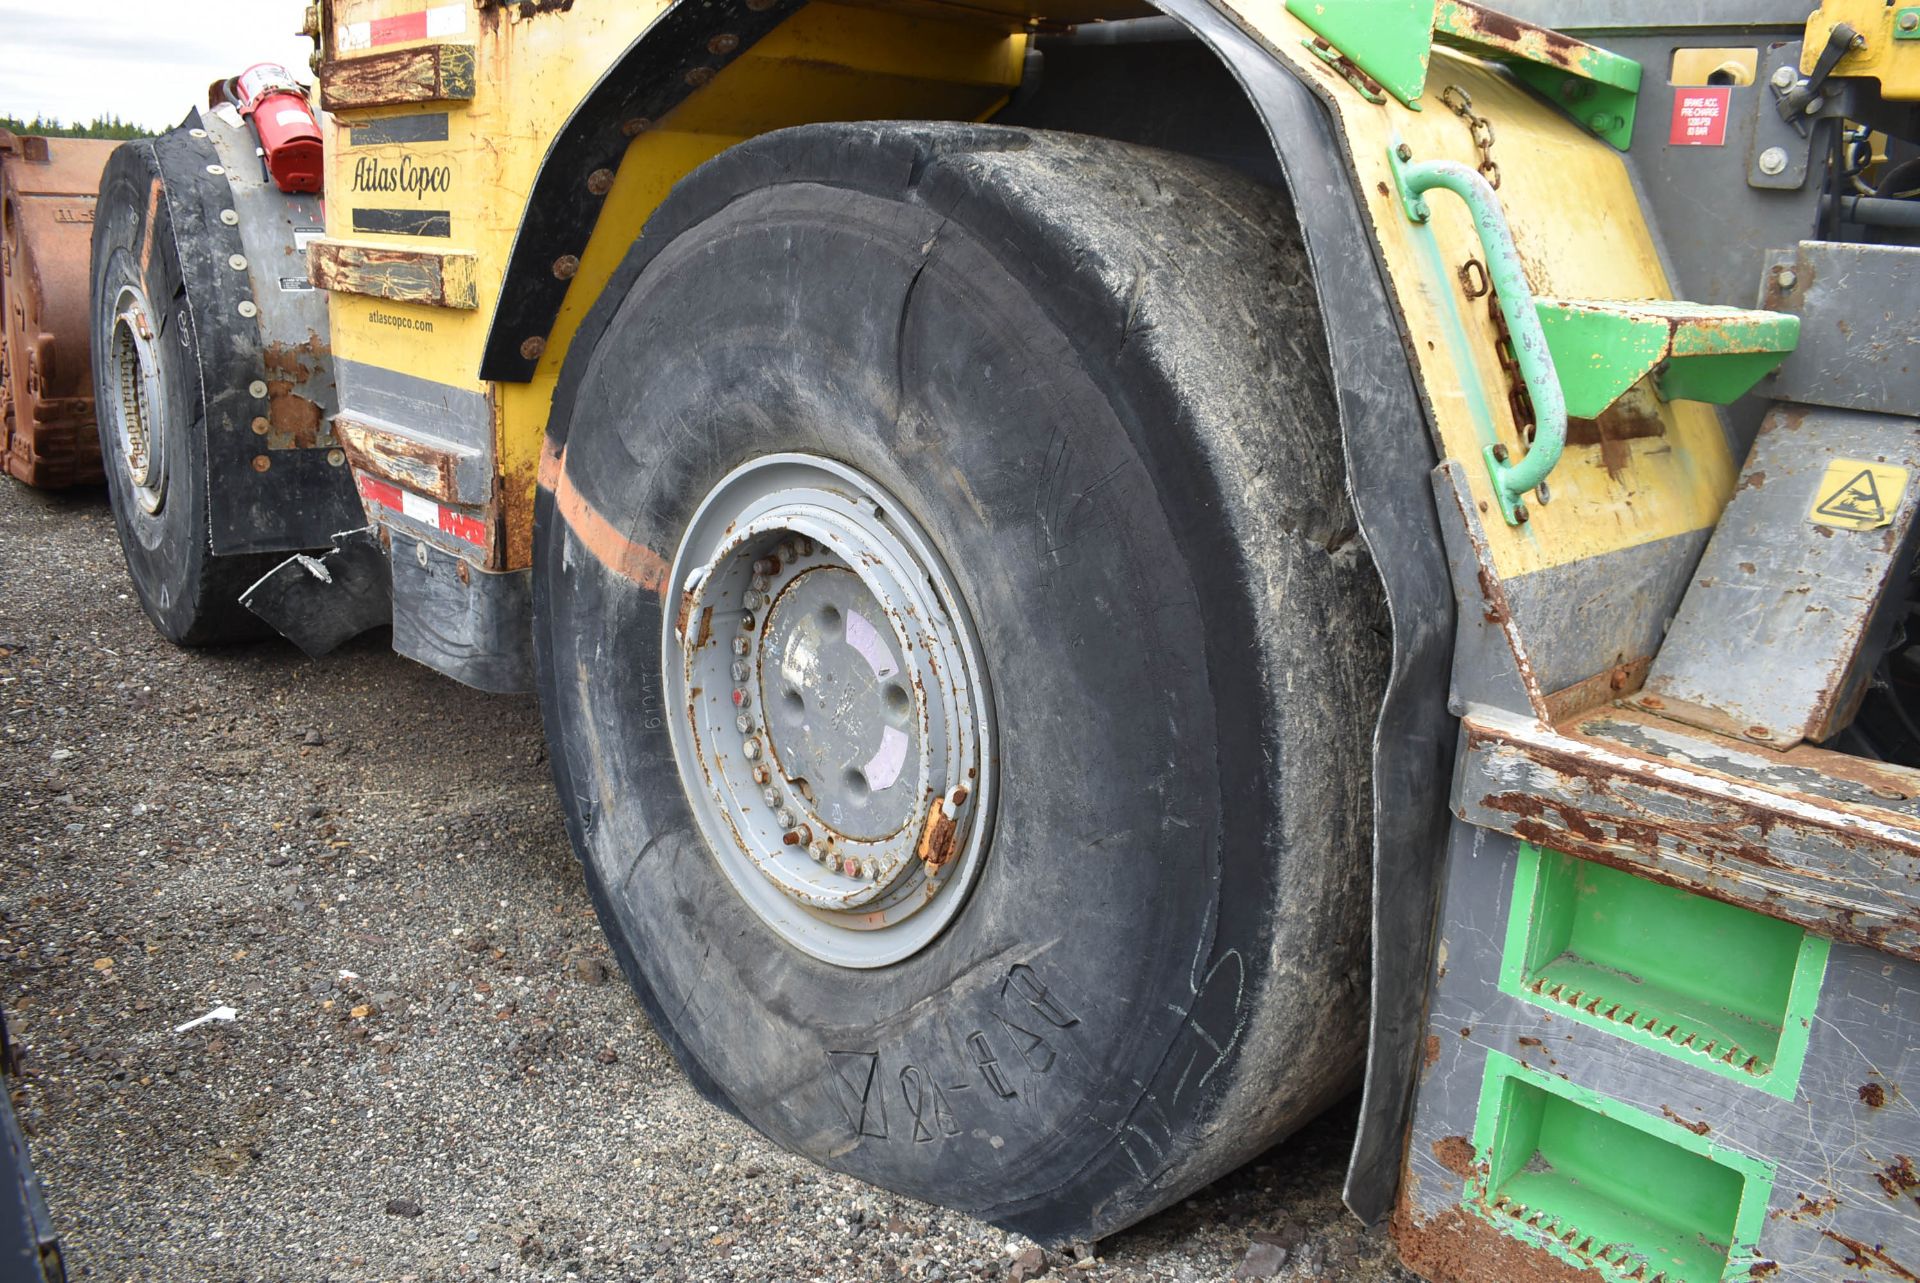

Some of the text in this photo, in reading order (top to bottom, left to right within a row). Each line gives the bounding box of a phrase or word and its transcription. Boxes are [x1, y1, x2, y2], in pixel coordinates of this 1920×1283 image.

[351, 154, 451, 201] Atlas Copco
[368, 310, 434, 333] atlascopco.com
